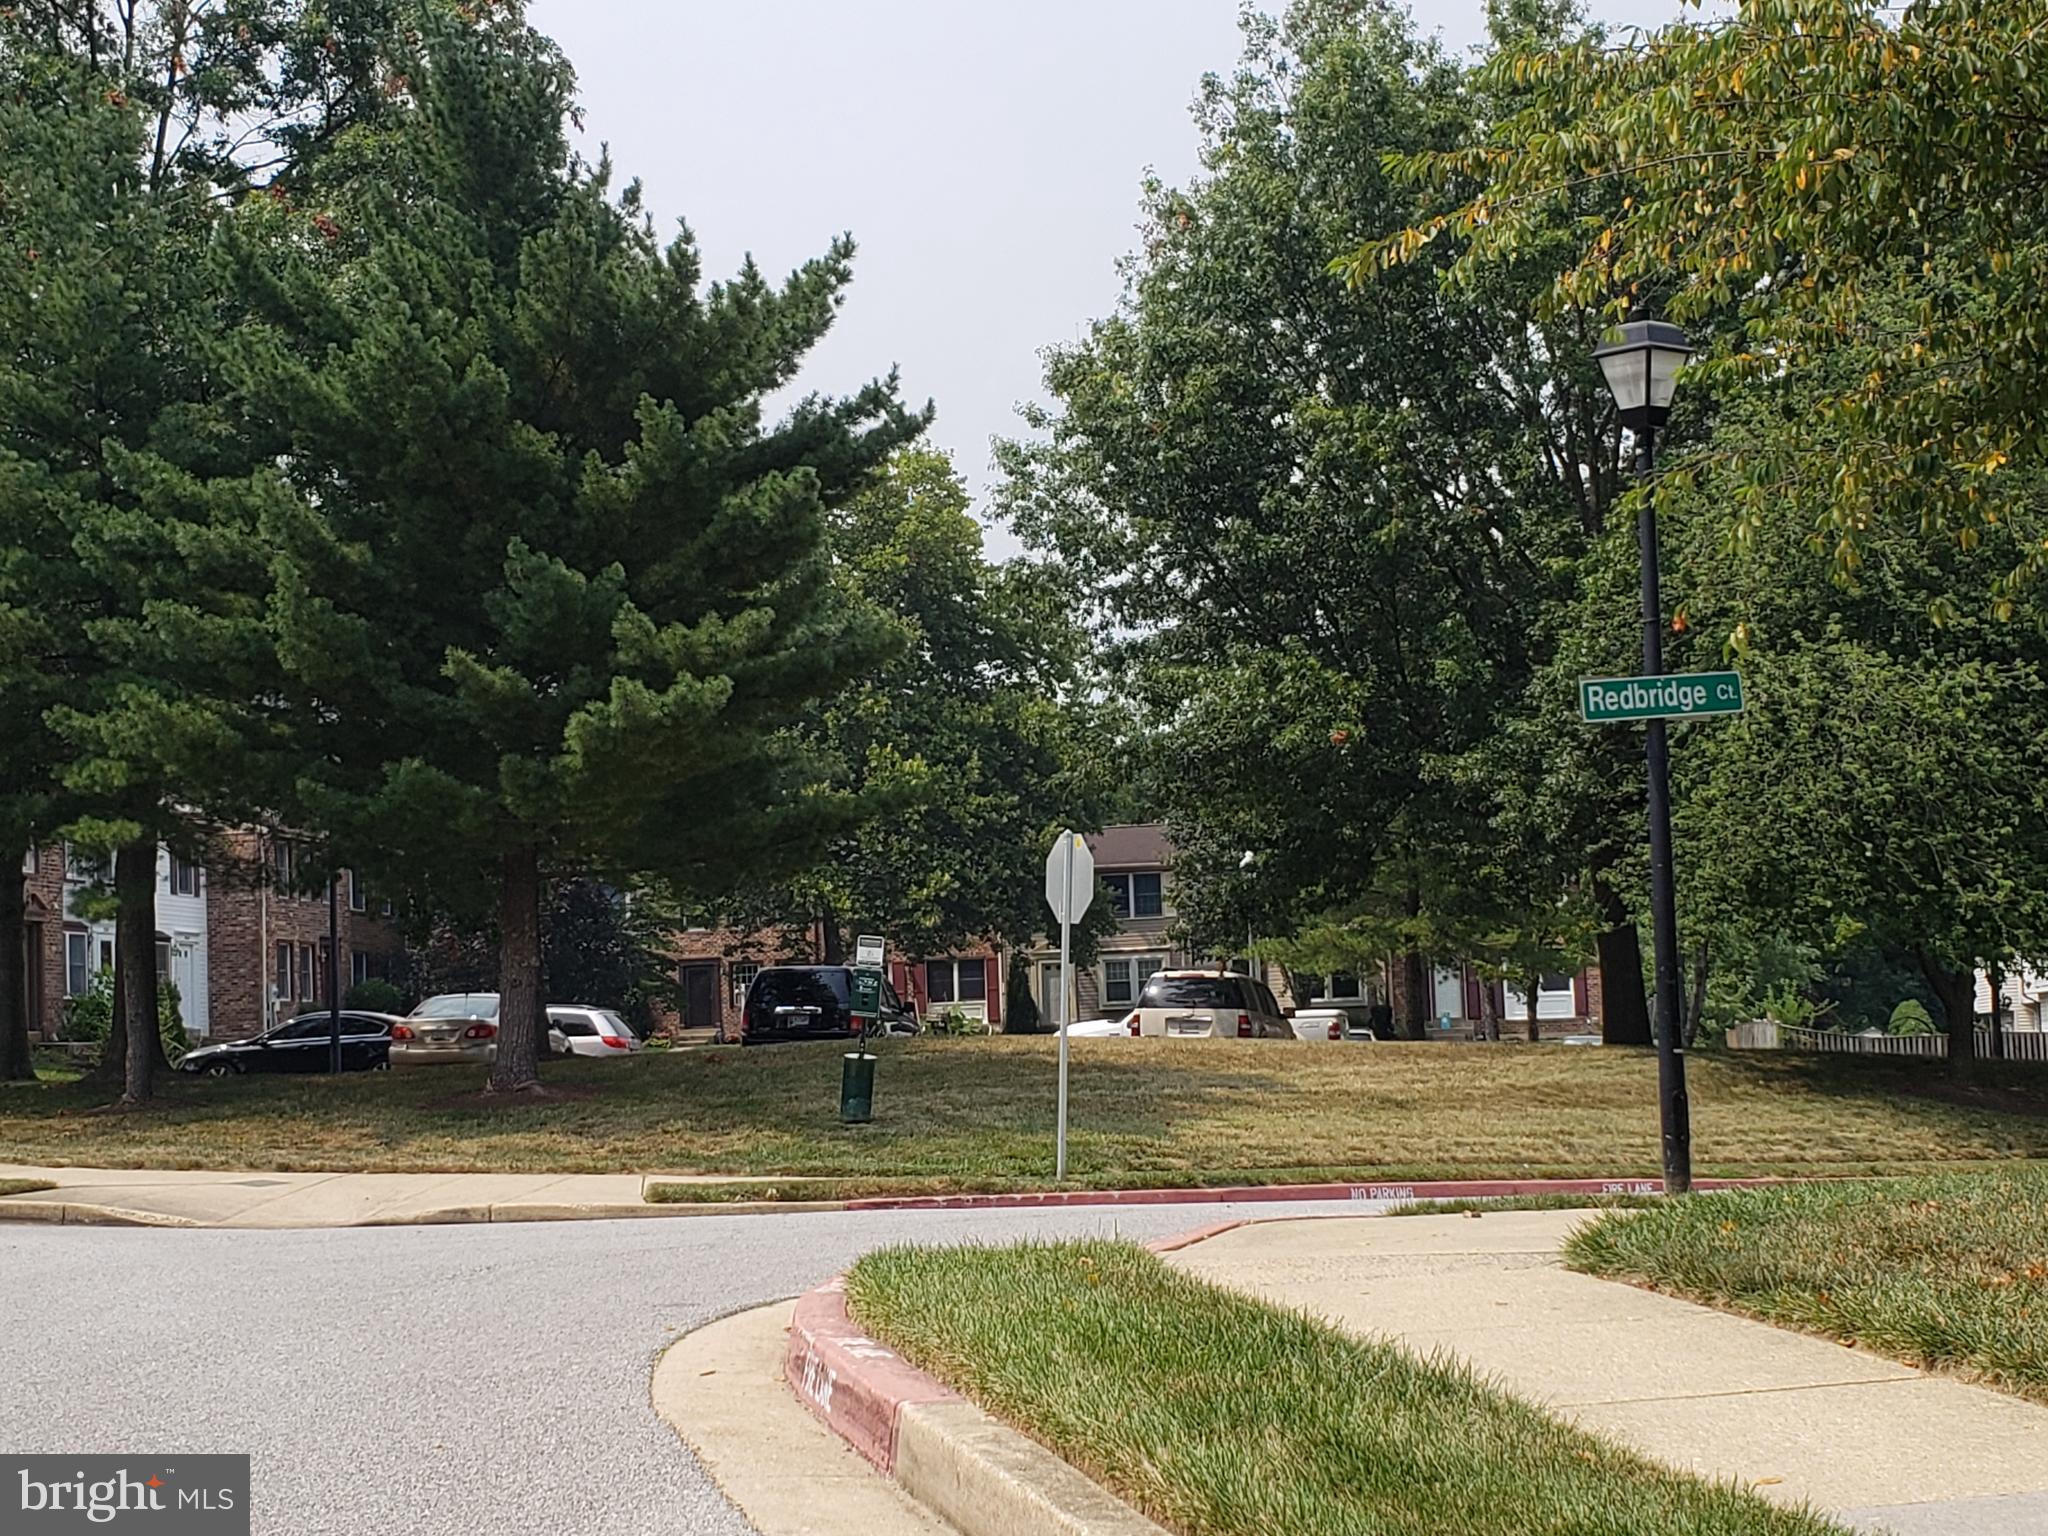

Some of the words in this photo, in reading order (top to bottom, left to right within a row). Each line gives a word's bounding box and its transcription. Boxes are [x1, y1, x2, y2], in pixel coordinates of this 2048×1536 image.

[1587, 681, 1707, 711] Redbridge
[1350, 1187, 1367, 1200] NO
[1370, 1186, 1414, 1200] PARKING
